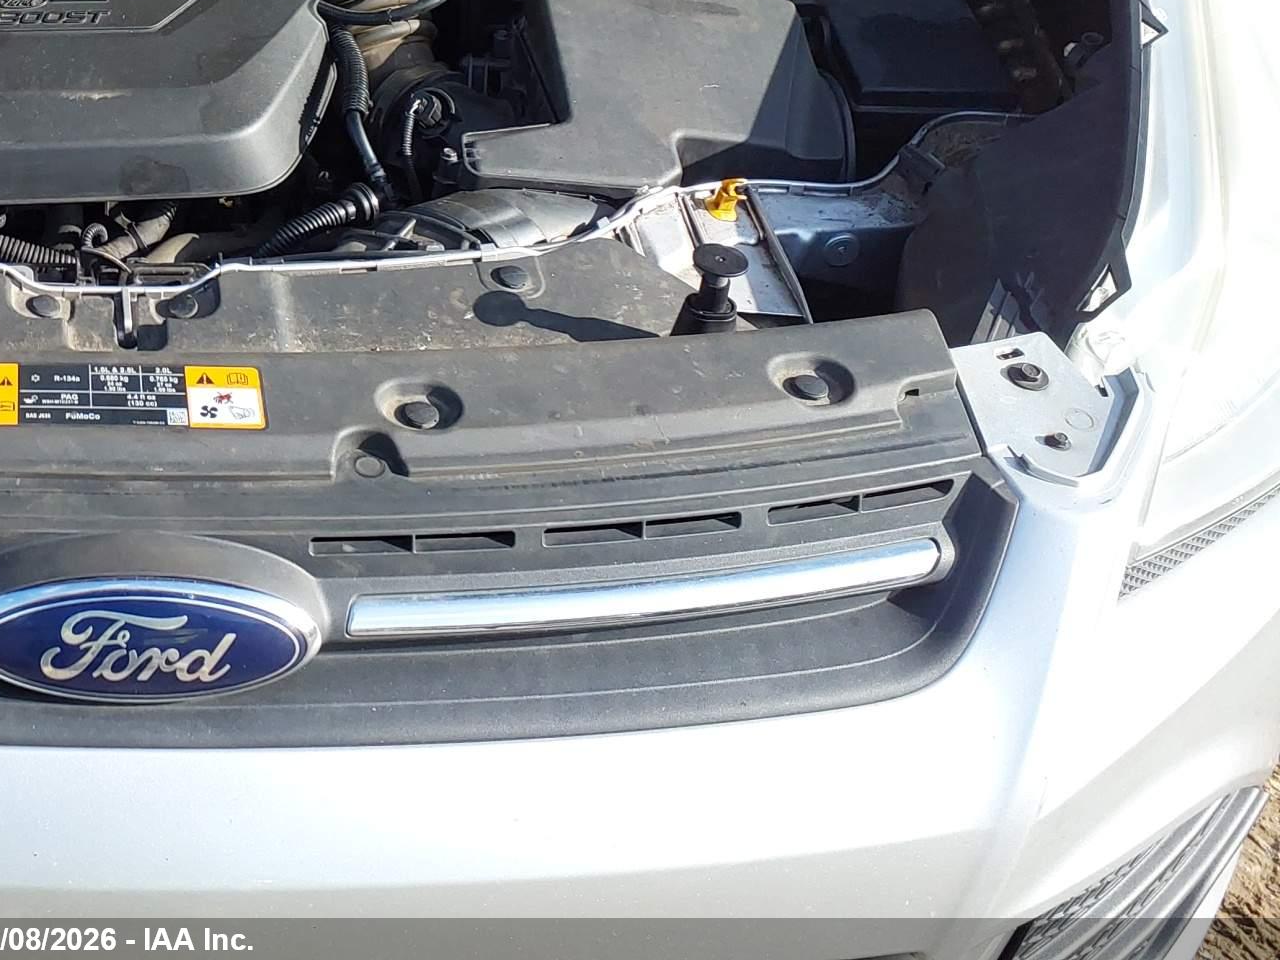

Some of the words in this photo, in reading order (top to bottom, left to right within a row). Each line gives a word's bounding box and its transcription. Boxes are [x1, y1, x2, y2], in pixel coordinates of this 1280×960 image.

[53, 374, 80, 382] R-134a
[61, 393, 79, 401] PAG
[39, 609, 236, 682] Ford
